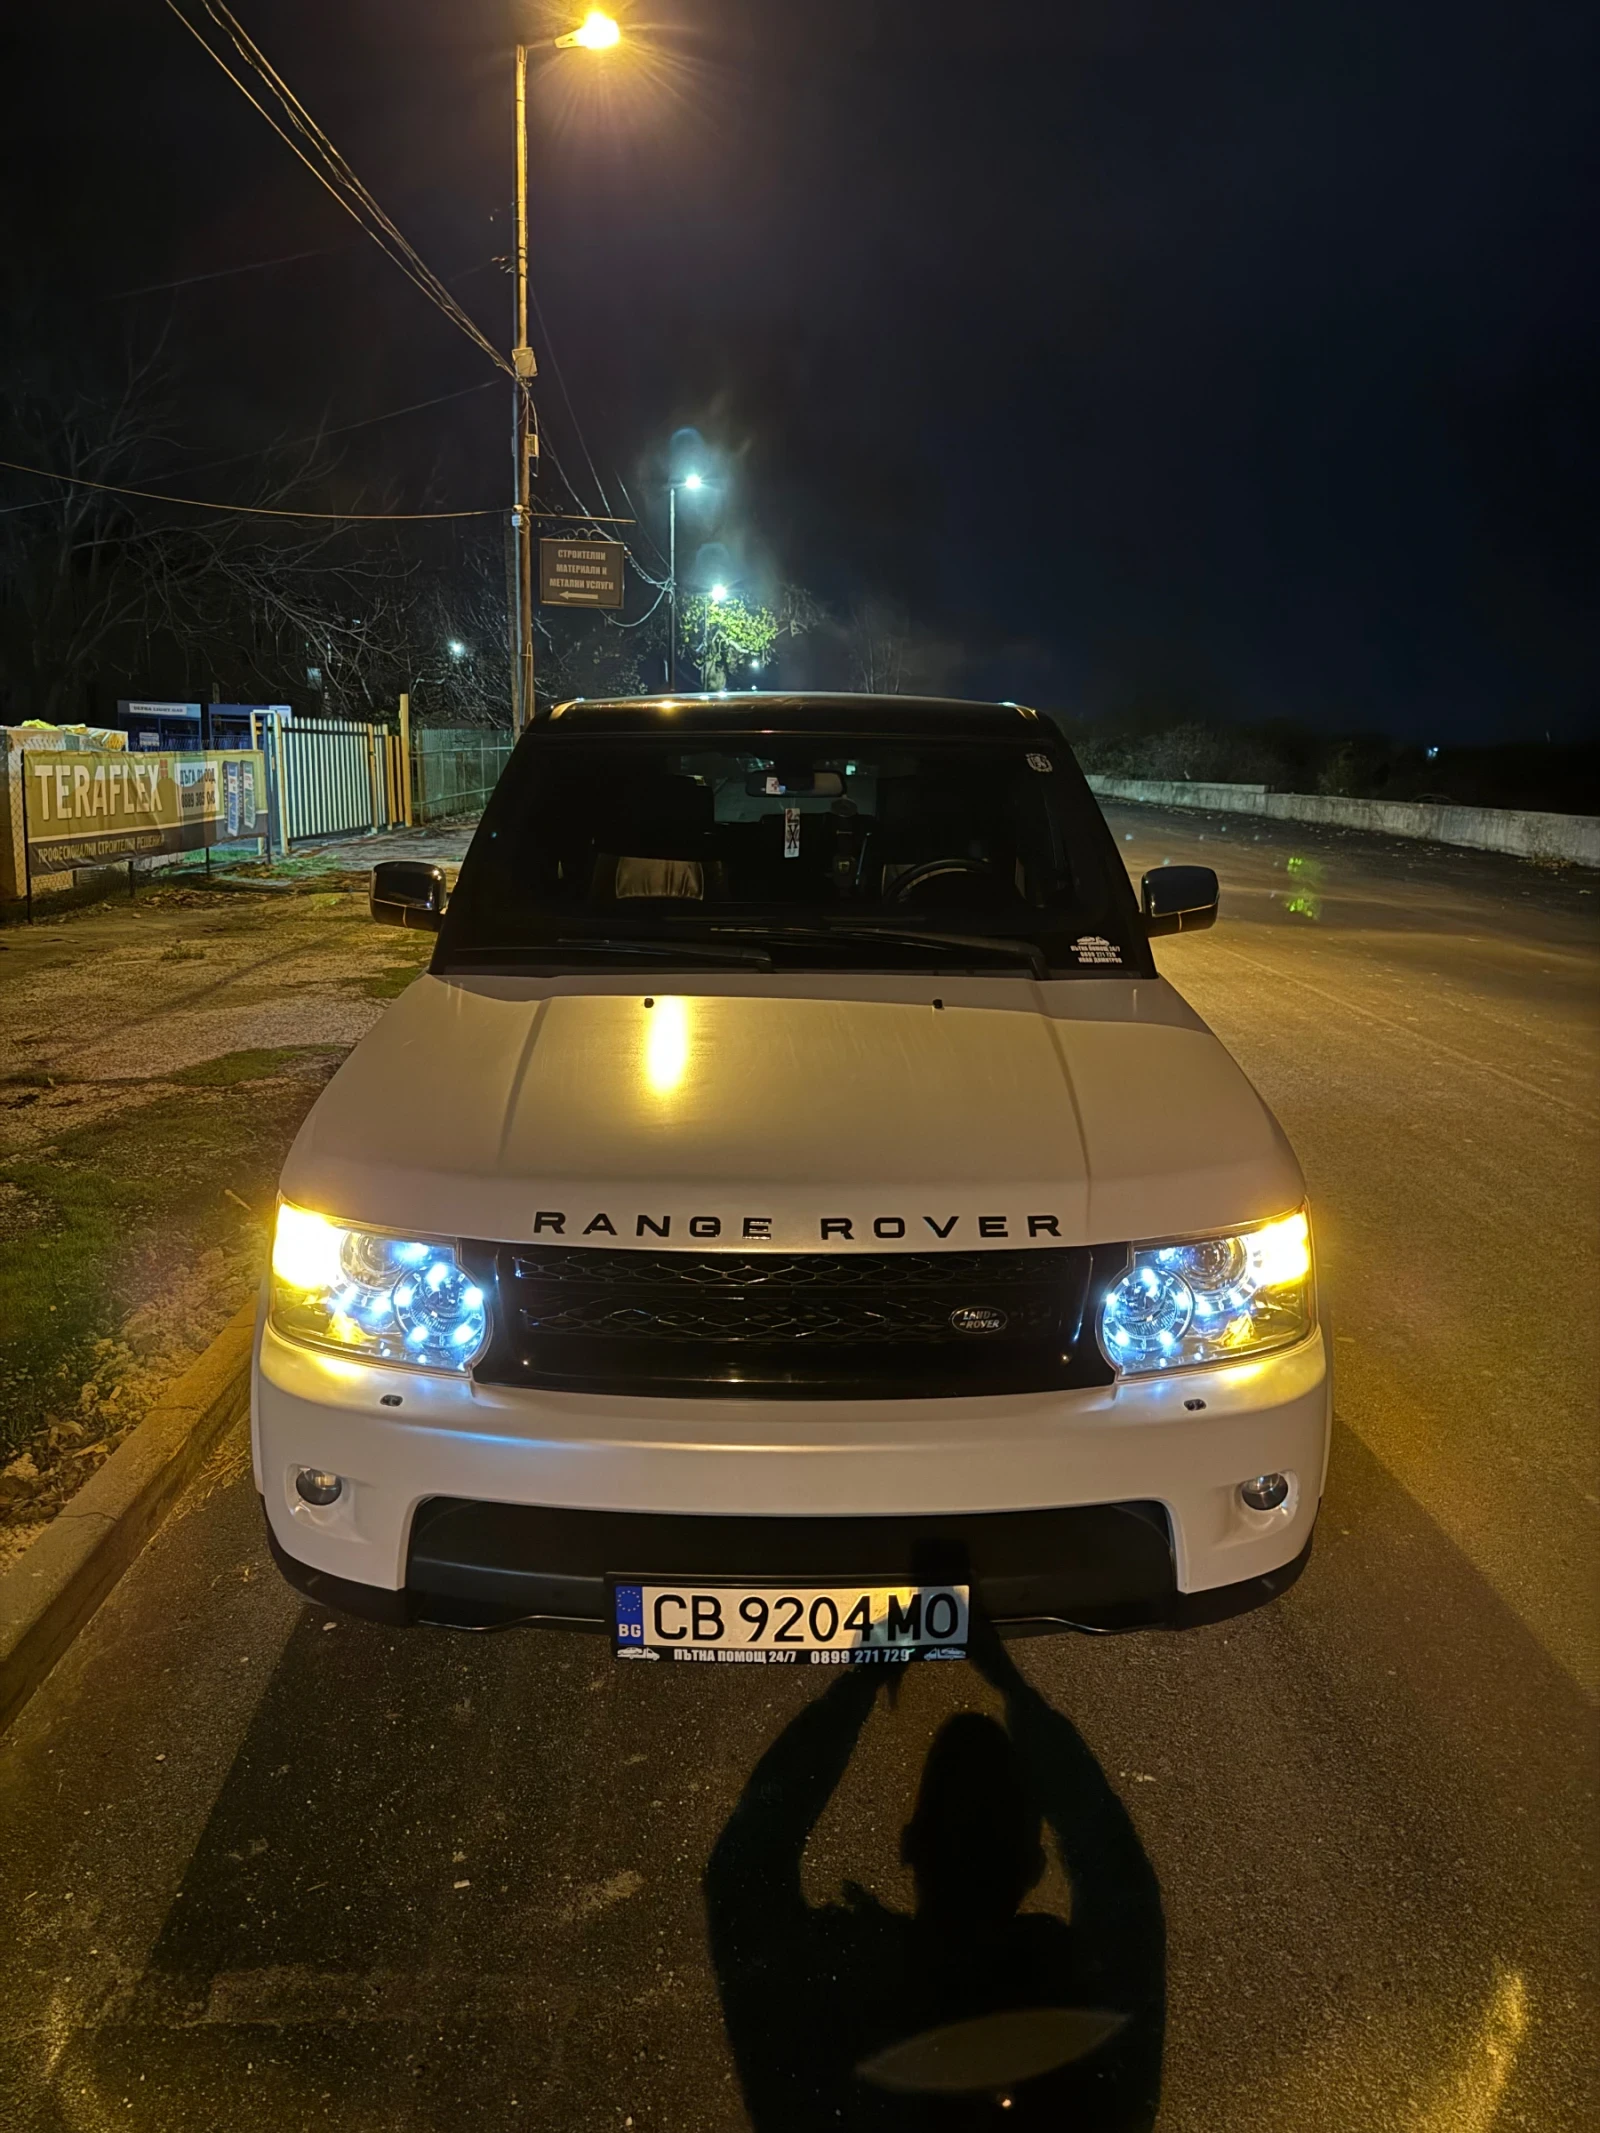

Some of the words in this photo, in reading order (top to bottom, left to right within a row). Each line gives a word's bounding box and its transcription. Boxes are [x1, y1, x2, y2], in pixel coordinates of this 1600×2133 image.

[557, 549, 606, 561] СТРОИТЕЛНИ
[556, 563, 601, 575] МАТЕРИАЛИ
[549, 578, 585, 589] МЕТАЛНИ
[586, 580, 614, 591] УСЛУГИ
[34, 764, 163, 820] TERAFLEX
[533, 1211, 772, 1240] RANGE
[820, 1214, 1062, 1241] ROVER
[654, 1594, 725, 1641] CB
[739, 1596, 874, 1643] 9204
[888, 1593, 958, 1641] MO
[618, 1624, 641, 1637] BG
[673, 1648, 715, 1662] ПЪТНА
[717, 1651, 766, 1663] ПОМОЩ
[769, 1651, 796, 1663] 24/7
[810, 1651, 850, 1664] 0899
[855, 1650, 880, 1663] 271
[883, 1649, 911, 1662] 729
